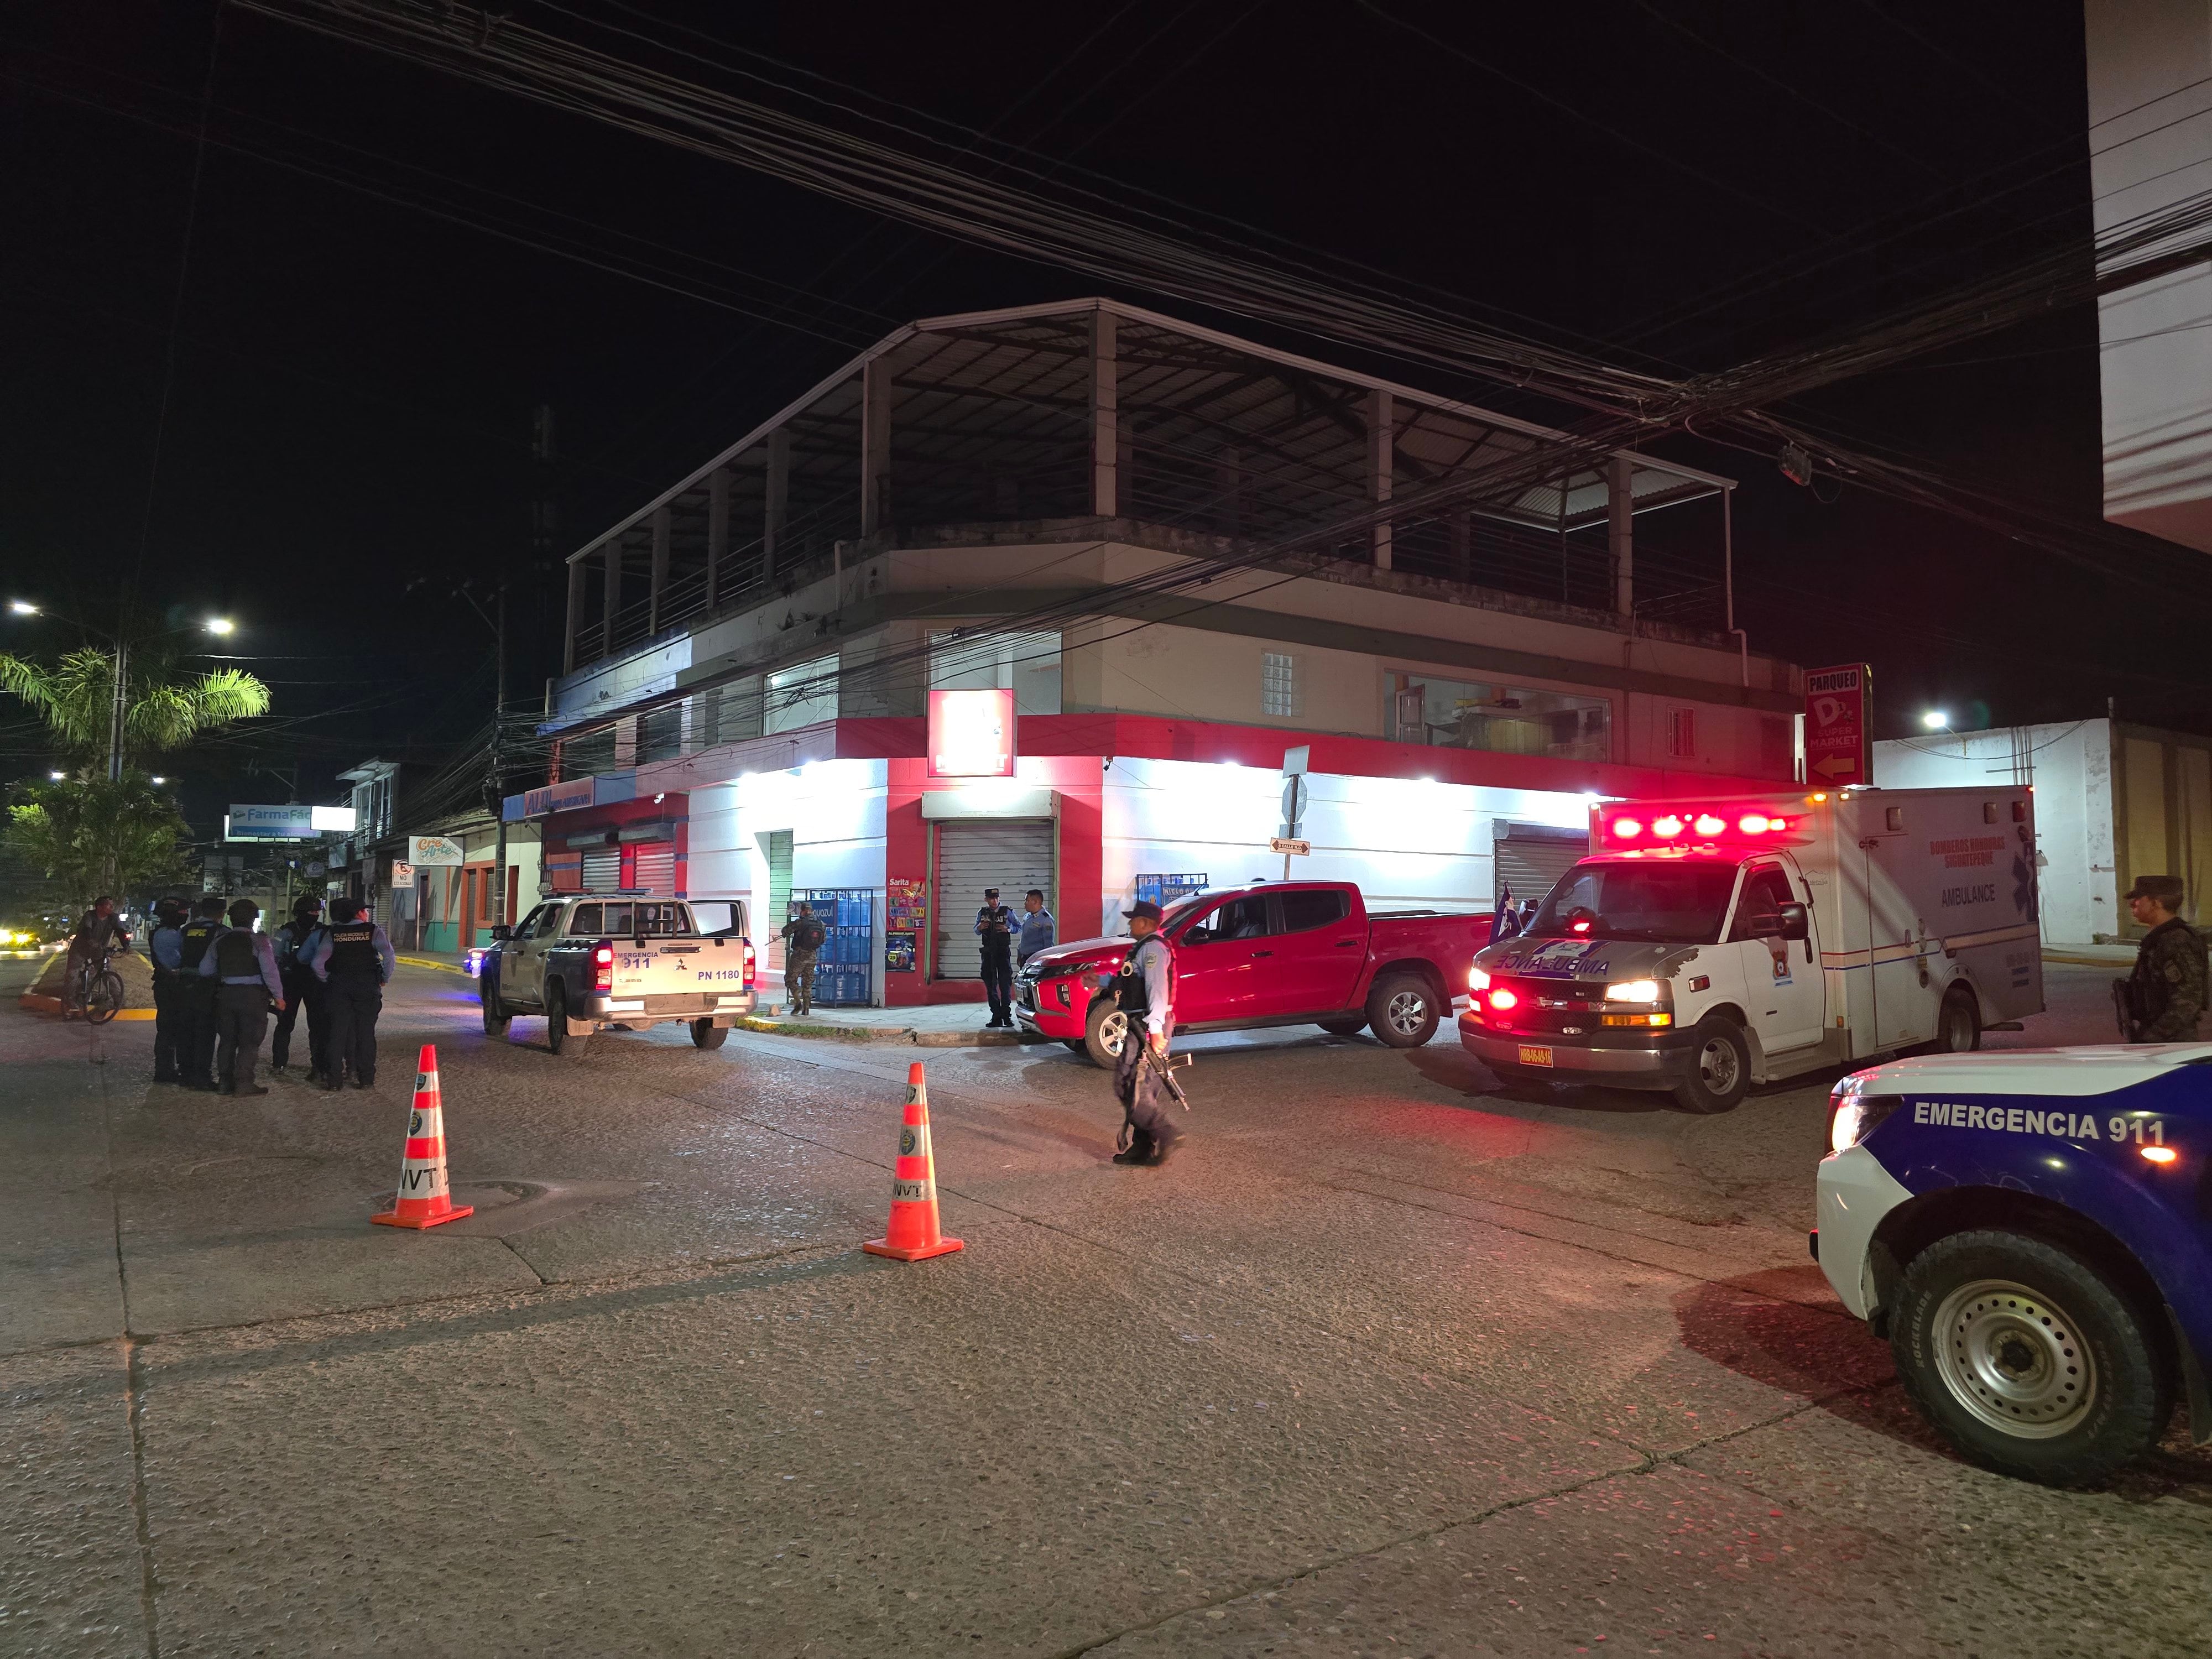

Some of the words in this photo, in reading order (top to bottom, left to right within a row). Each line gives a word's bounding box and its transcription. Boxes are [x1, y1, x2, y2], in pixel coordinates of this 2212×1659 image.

[1809, 672, 1856, 691] PARQUEO
[1818, 727, 1852, 737] SUPER
[1810, 735, 1858, 748] MARKET
[248, 808, 311, 822] FarmaFác
[1930, 838, 1970, 855] BOMBEROS
[1970, 836, 2006, 852] HONDURAS
[1944, 851, 1994, 869] SIGUATEPEQUE
[1942, 884, 1995, 907] AMBULANCE
[812, 905, 833, 920] guazul
[622, 958, 650, 968] 911
[698, 971, 712, 980] PN
[716, 970, 739, 979] 1180
[1914, 1102, 2100, 1140] EMERGENCIA
[2109, 1117, 2164, 1146] 911
[893, 1183, 922, 1197] NVT
